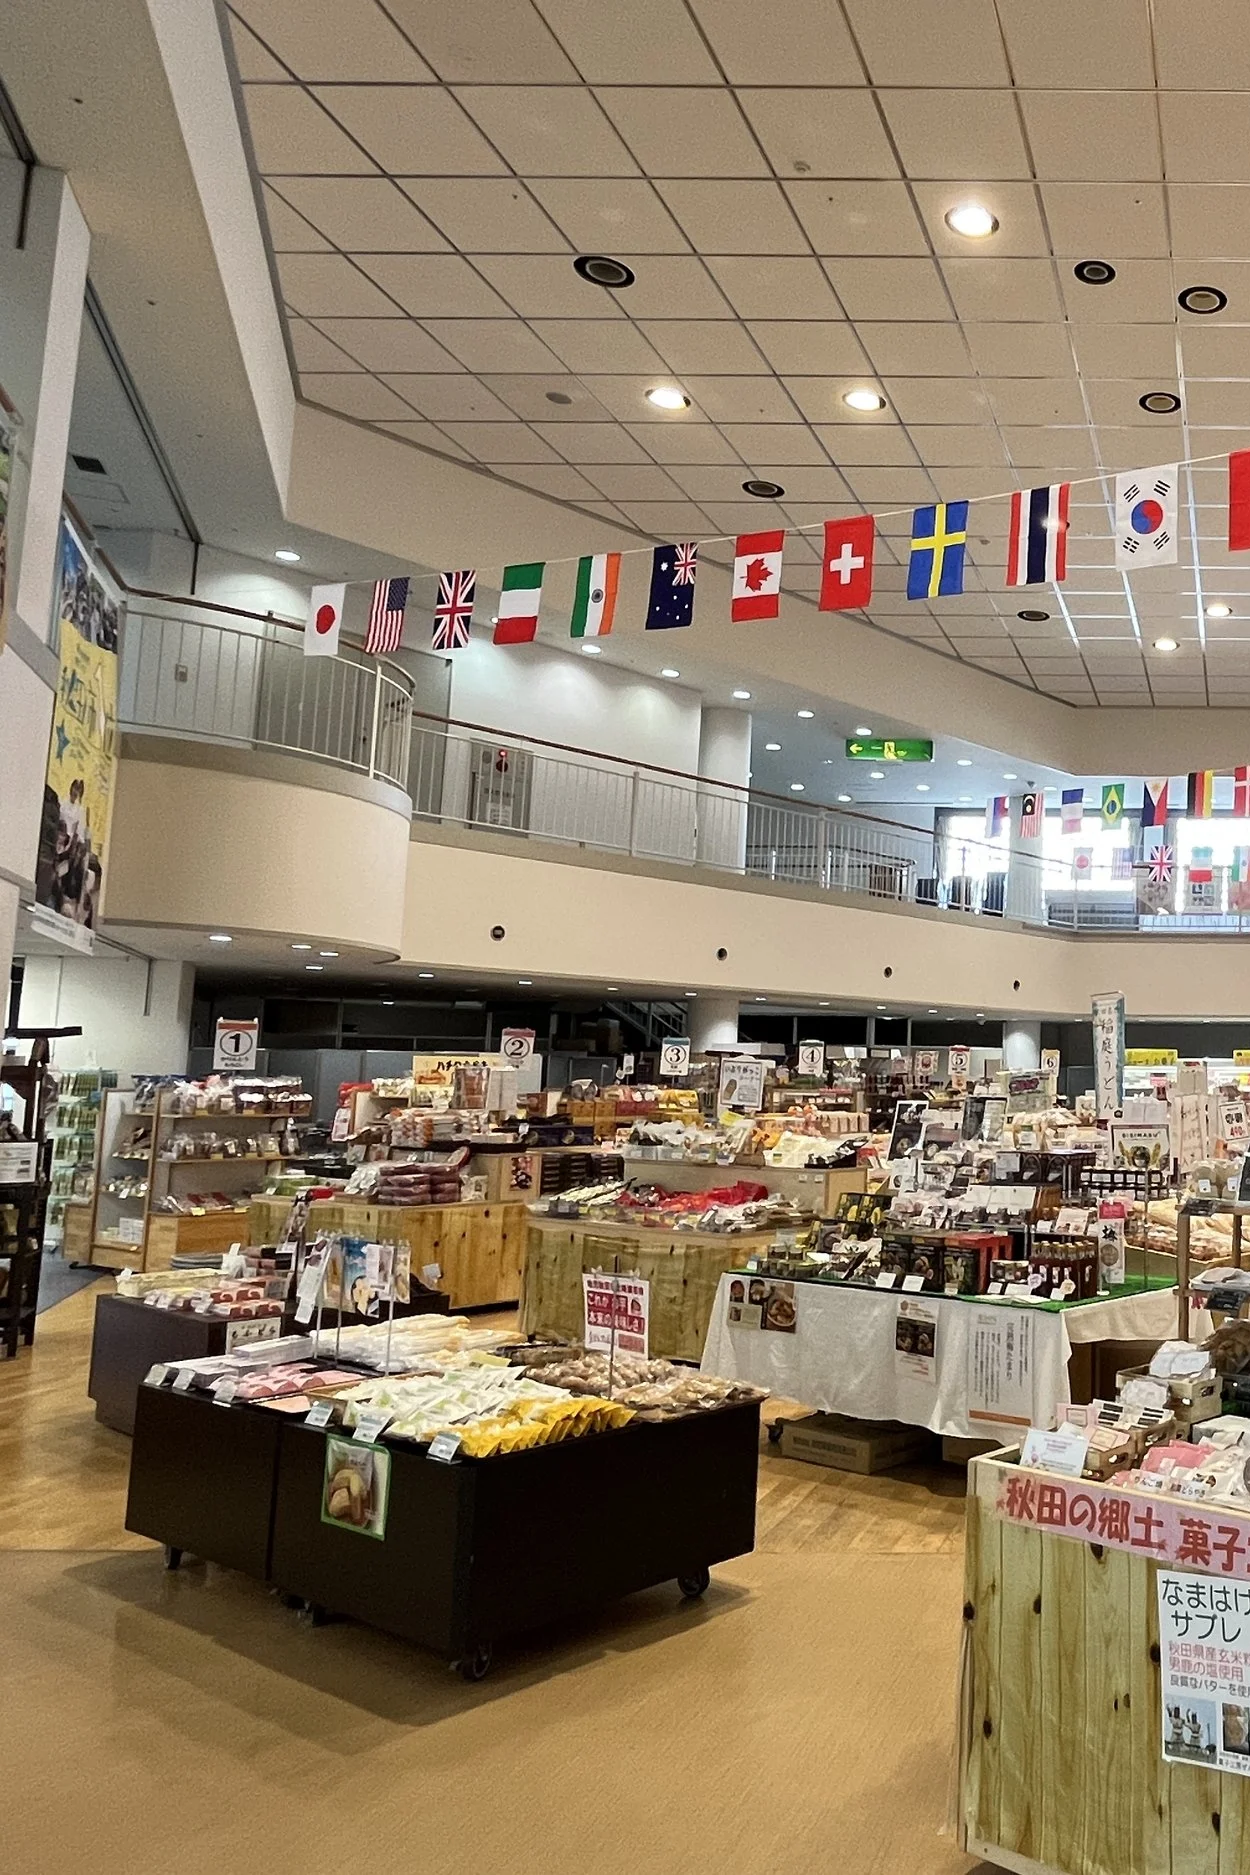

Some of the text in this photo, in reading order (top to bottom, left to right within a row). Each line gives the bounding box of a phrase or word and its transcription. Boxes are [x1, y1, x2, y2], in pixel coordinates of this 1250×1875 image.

[1098, 1018, 1115, 1111] 稲庭うどん
[1169, 1656, 1244, 1683] 男鹿の塩使用
